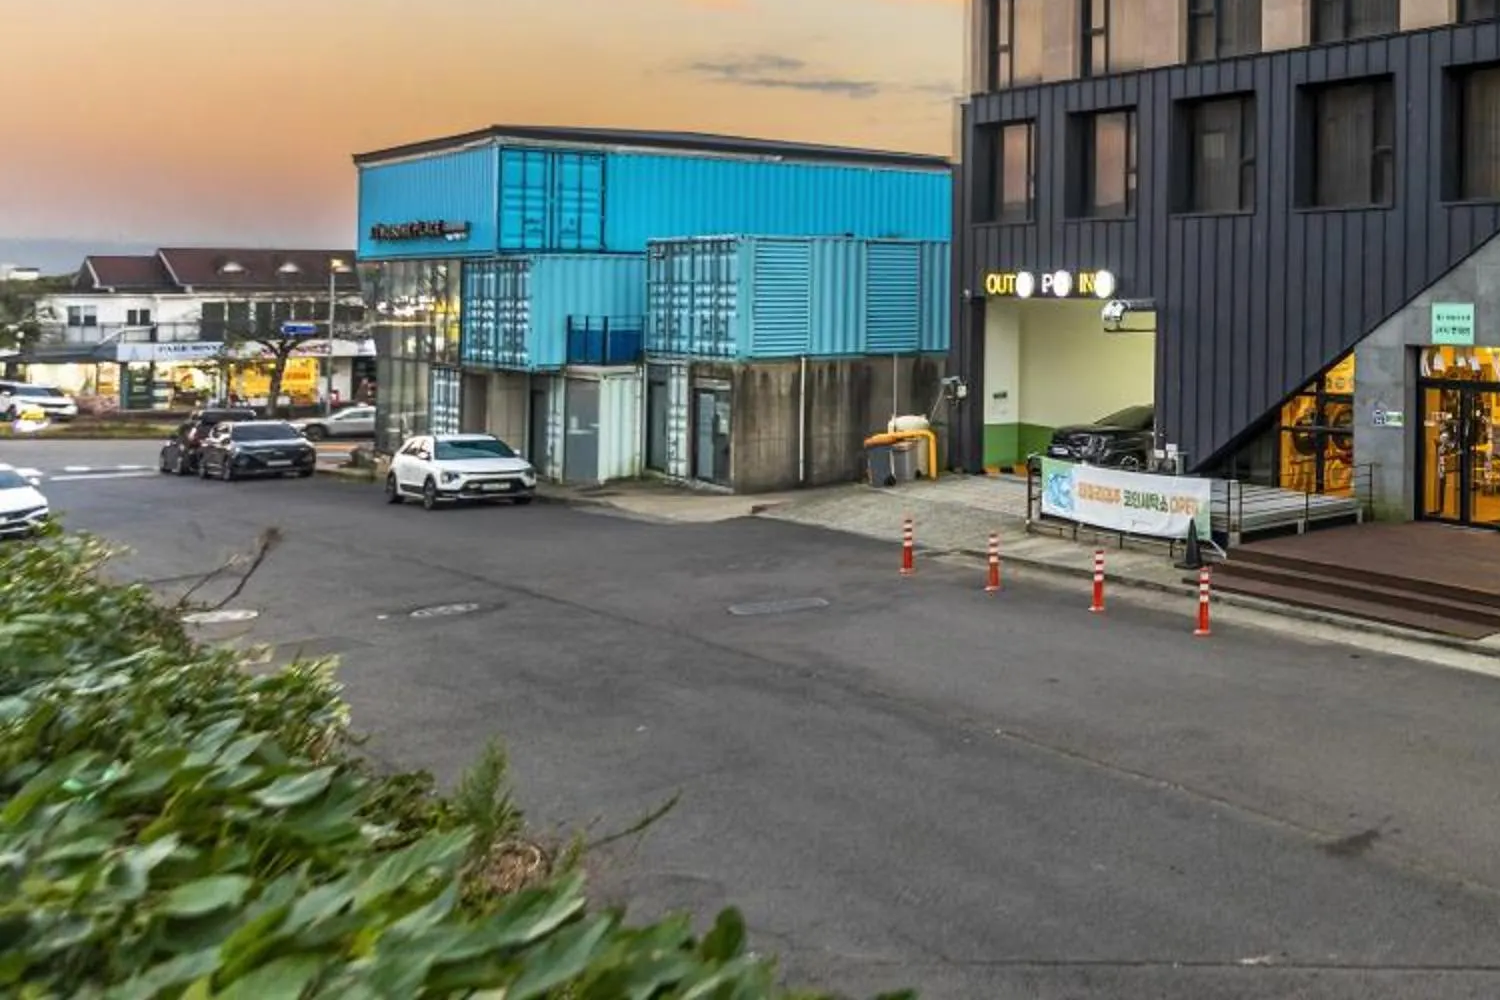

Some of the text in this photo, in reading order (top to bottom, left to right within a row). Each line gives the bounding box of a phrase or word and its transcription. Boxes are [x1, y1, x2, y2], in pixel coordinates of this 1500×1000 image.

[986, 273, 1016, 295] OUT
[1041, 272, 1054, 294] P
[1079, 272, 1095, 294] IN
